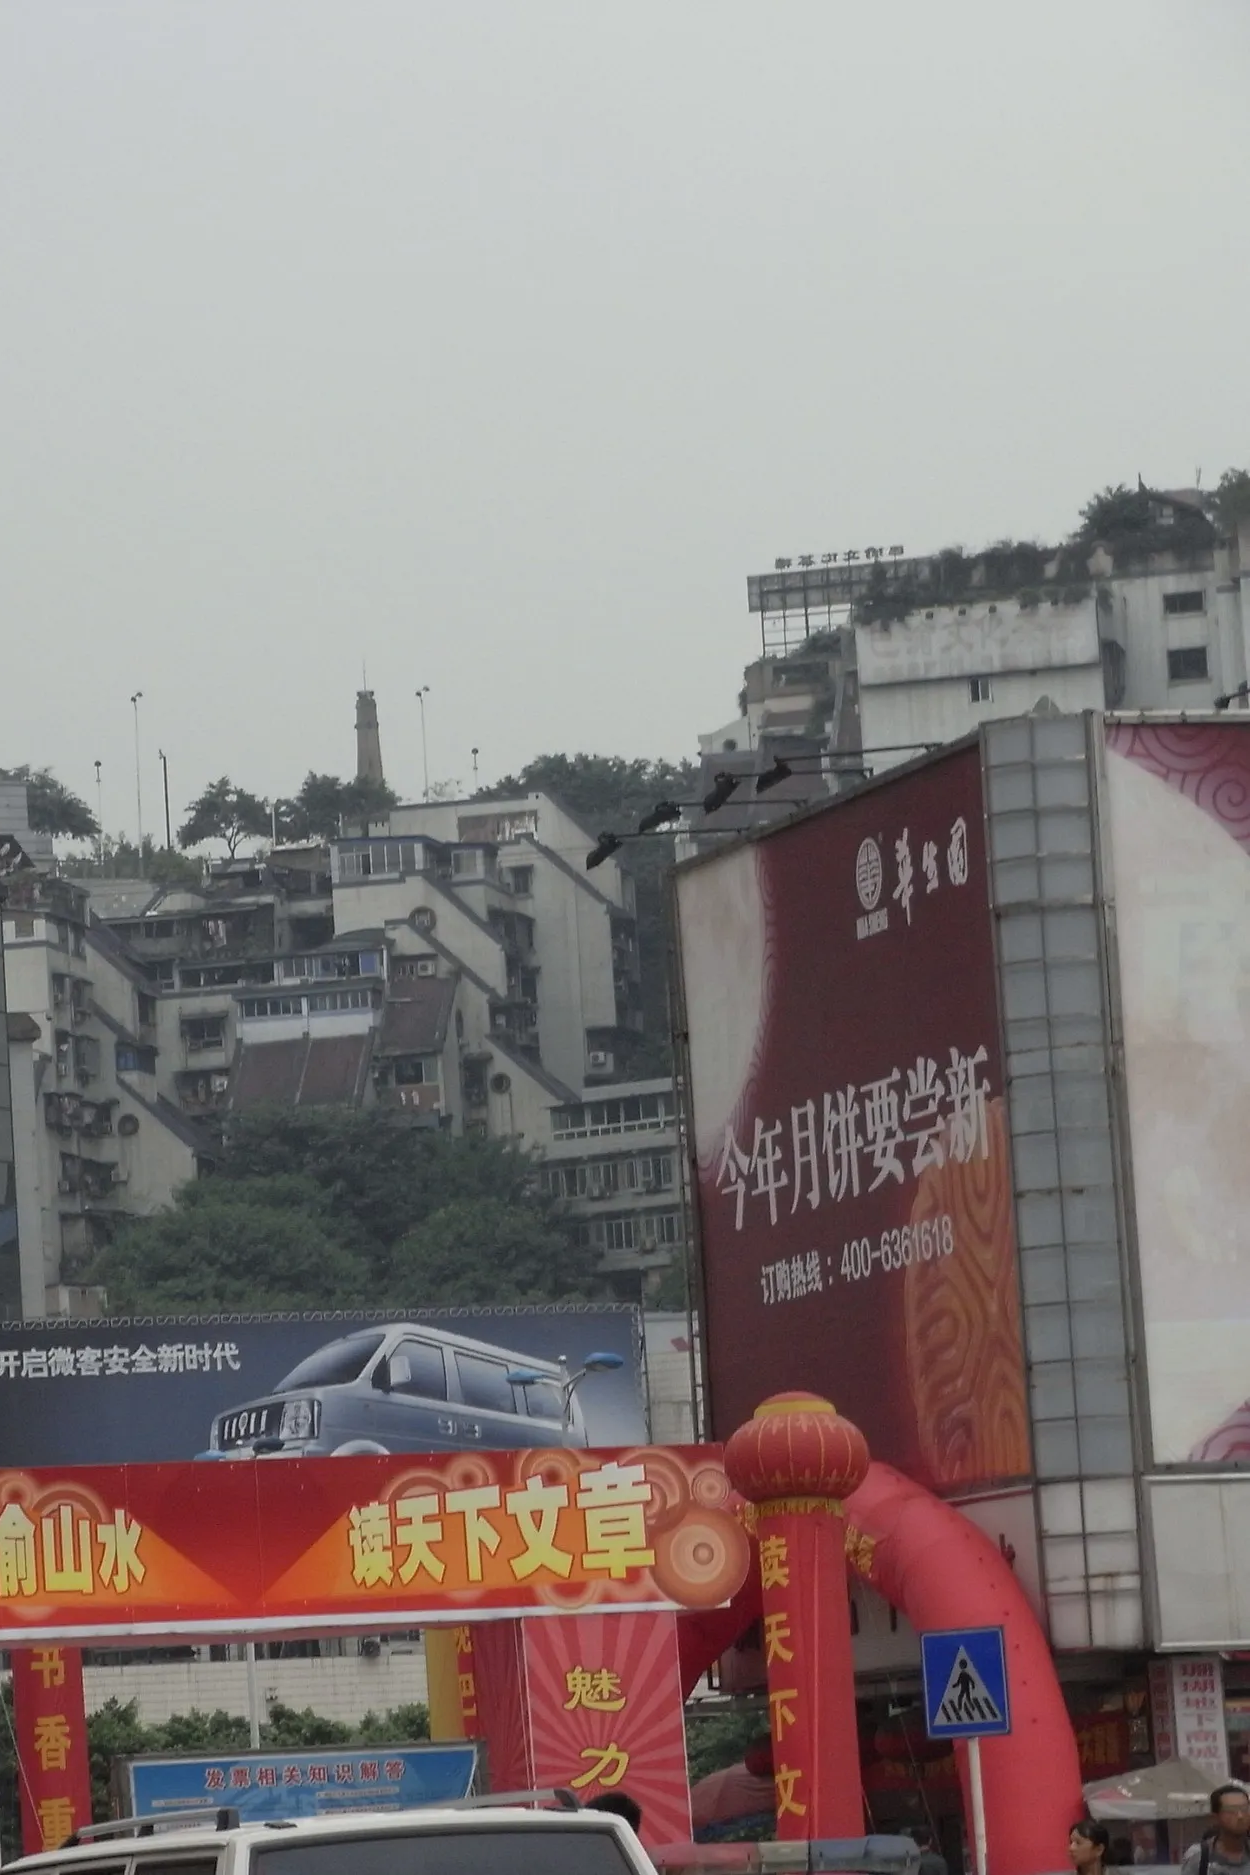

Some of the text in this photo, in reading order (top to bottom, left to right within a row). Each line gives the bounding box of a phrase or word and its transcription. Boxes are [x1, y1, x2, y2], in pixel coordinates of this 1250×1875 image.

[716, 1045, 990, 1231] 今年月饼要尝新
[349, 1461, 655, 1590] 读天下文章
[565, 1666, 630, 1790] 魅力
[759, 1533, 807, 1819] 读天下文
[205, 1759, 406, 1789] 发票相关知识解答
